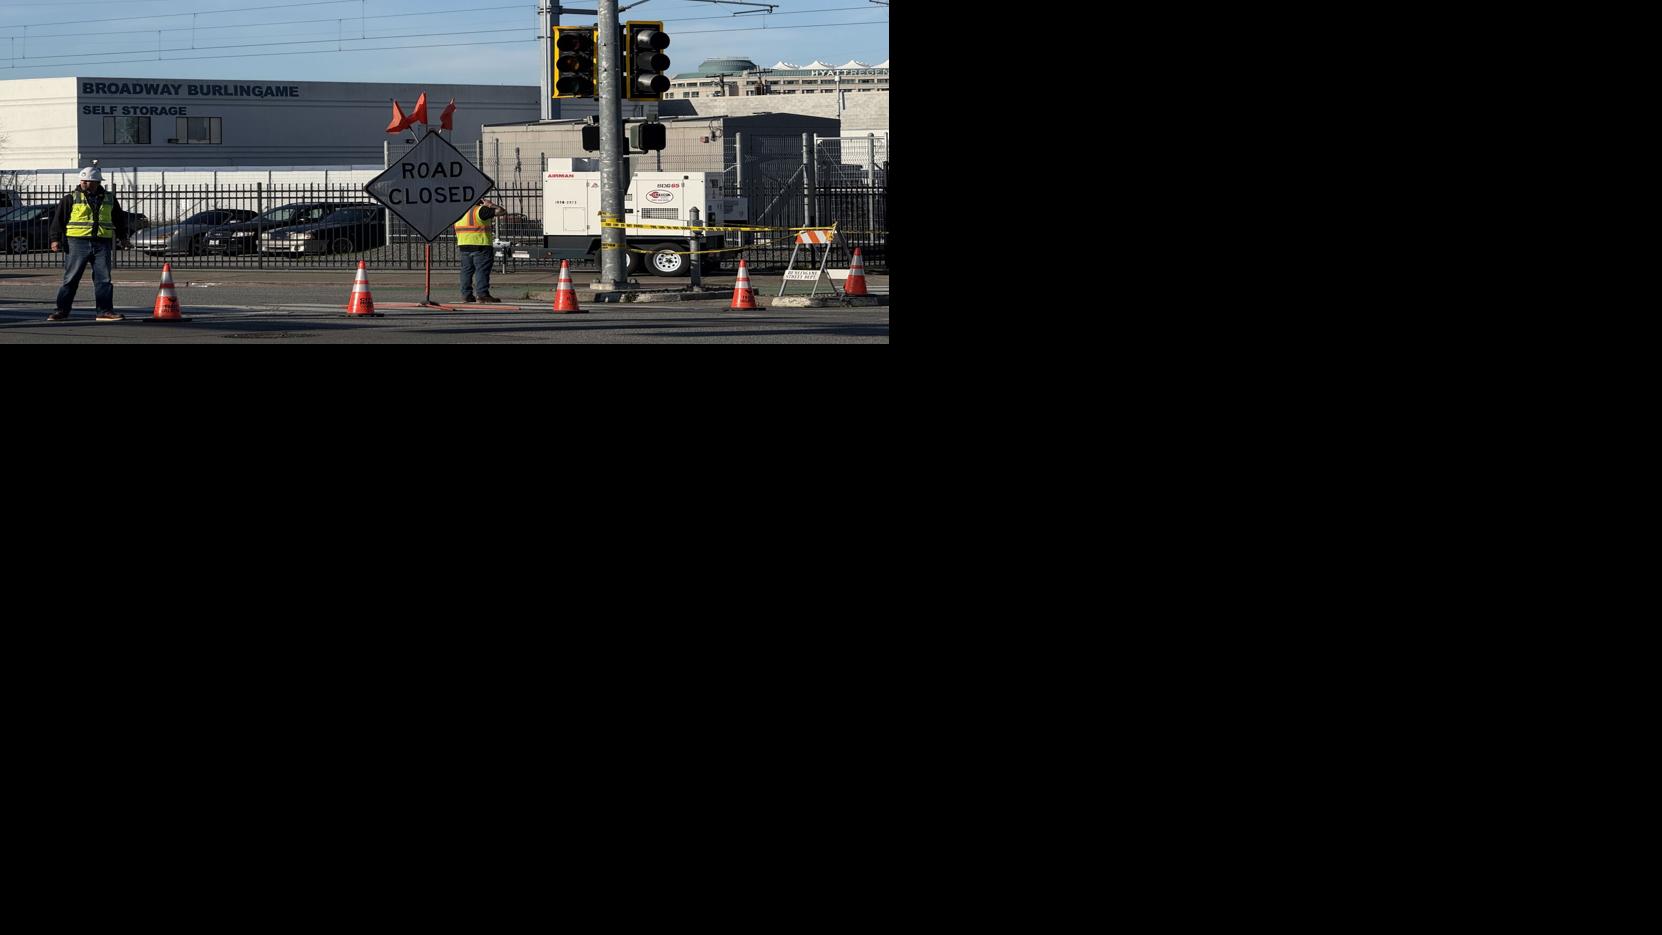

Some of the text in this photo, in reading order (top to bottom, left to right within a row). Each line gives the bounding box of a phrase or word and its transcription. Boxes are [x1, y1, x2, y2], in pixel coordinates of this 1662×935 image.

[82, 82, 299, 98] BROADWAY BURLINGAME
[82, 105, 187, 116] SELF STORAGE
[402, 161, 463, 179] ROAD
[388, 186, 475, 205] CLOSED
